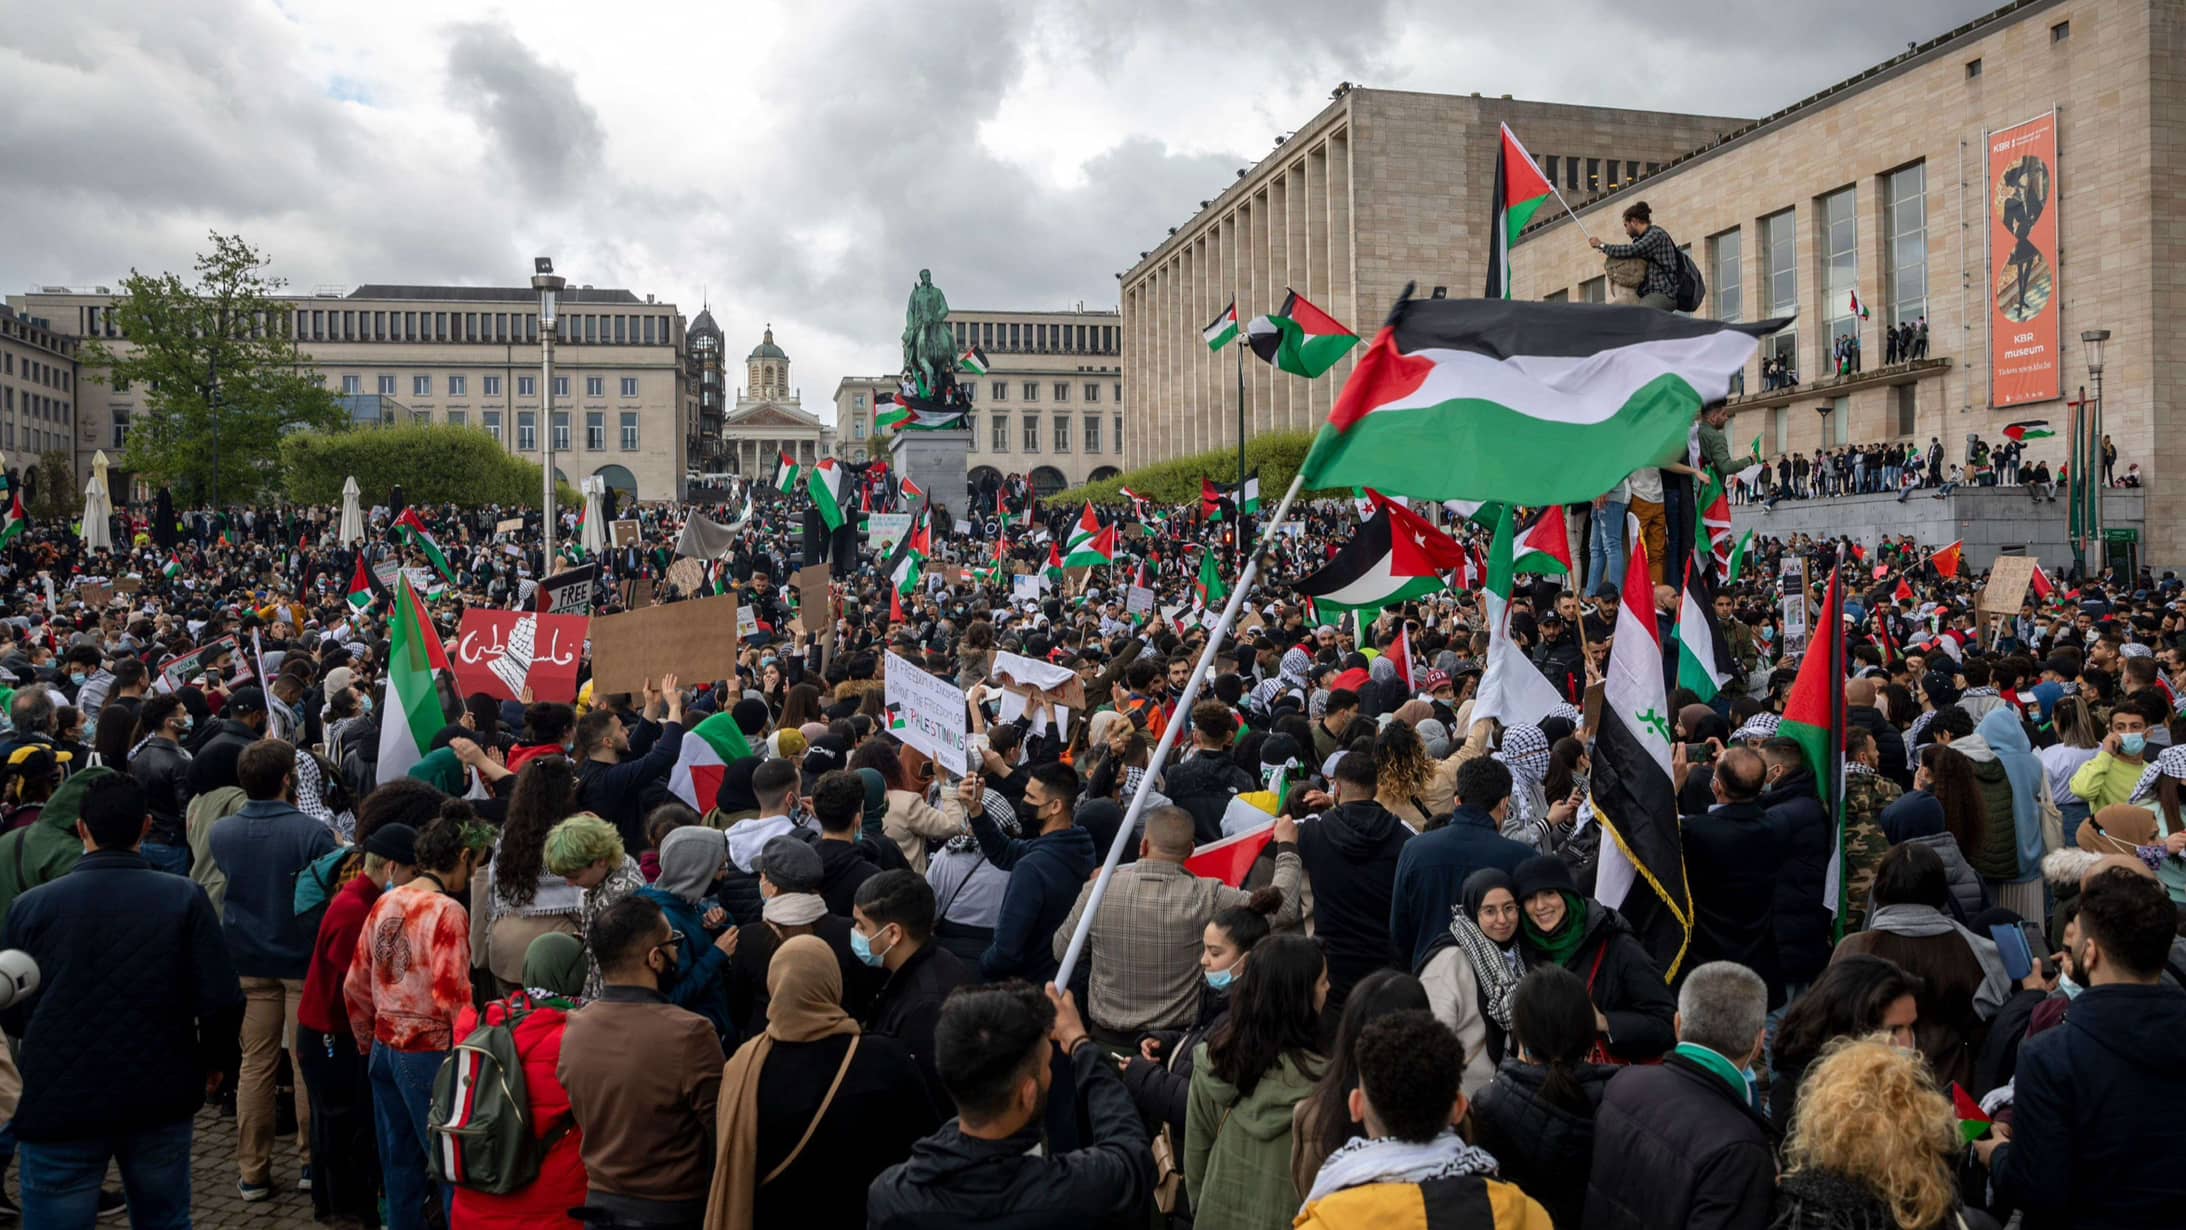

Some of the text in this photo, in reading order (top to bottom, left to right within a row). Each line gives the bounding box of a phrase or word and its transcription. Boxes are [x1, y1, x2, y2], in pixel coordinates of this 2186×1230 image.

[2014, 332, 2034, 345] KBR
[2004, 344, 2045, 360] museum
[560, 583, 588, 607] FREE
[1426, 671, 1448, 684] ICON
